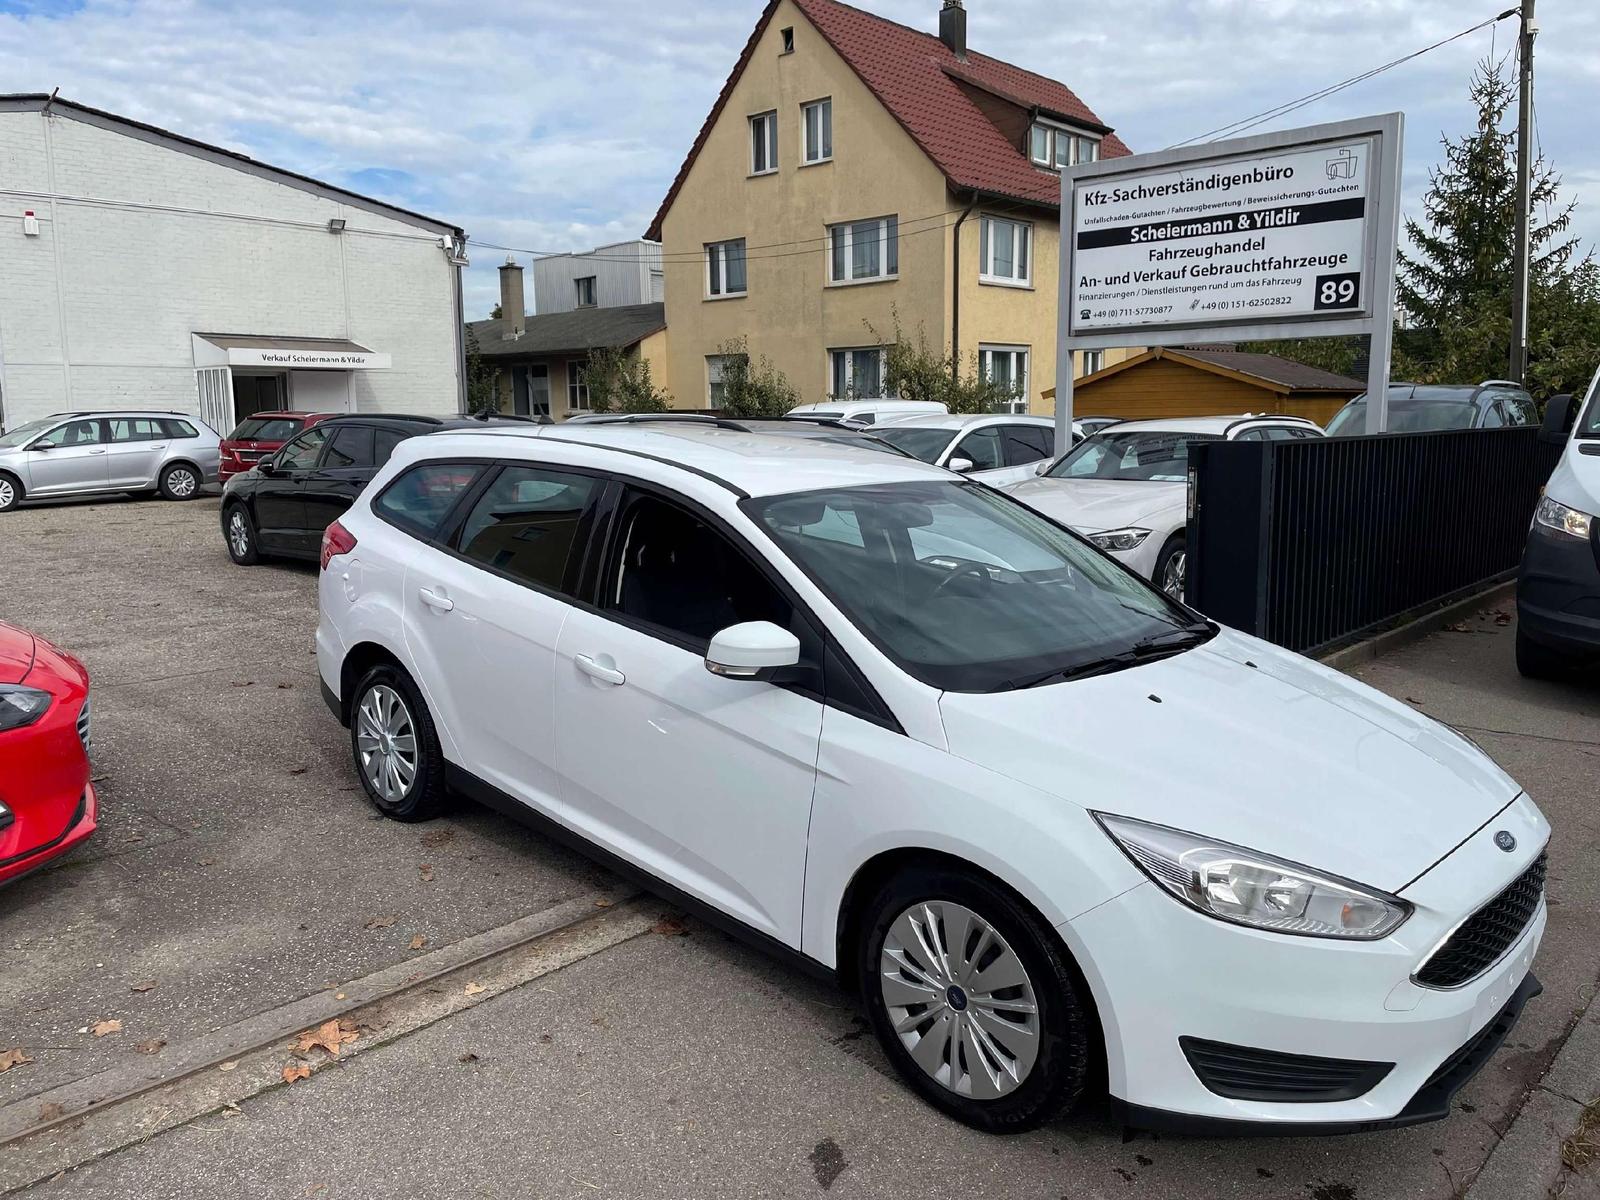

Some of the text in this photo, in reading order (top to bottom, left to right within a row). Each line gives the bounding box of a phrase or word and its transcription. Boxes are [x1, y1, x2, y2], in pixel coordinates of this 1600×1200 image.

[1085, 166, 1294, 206] Kfz-Sachverständigenbüro
[1084, 209, 1166, 225] Unfallschaden-Gutachten
[1171, 199, 1242, 214] Fahrzeugbewertung
[1247, 184, 1359, 205] Beweissicherungs-Gutachten
[1130, 208, 1300, 242] Scheiermann & Yildir
[1149, 236, 1265, 261] Fahrzeughandel
[1080, 253, 1348, 288] An- und Verkauf Gebrauchtfahrzeuge
[1079, 290, 1135, 301] Finanzierungen
[1142, 284, 1207, 296] Dienstleistungen
[1209, 281, 1228, 291] rund
[1245, 279, 1260, 288] das
[1261, 277, 1302, 287] Fahrzeug
[1320, 279, 1355, 304] 89
[1093, 305, 1173, 319] +49 (0) 711-57730877
[1201, 296, 1292, 311] +49 (0) 151-62502822
[261, 353, 291, 362] Verkauf
[292, 355, 340, 363] Scheiermann
